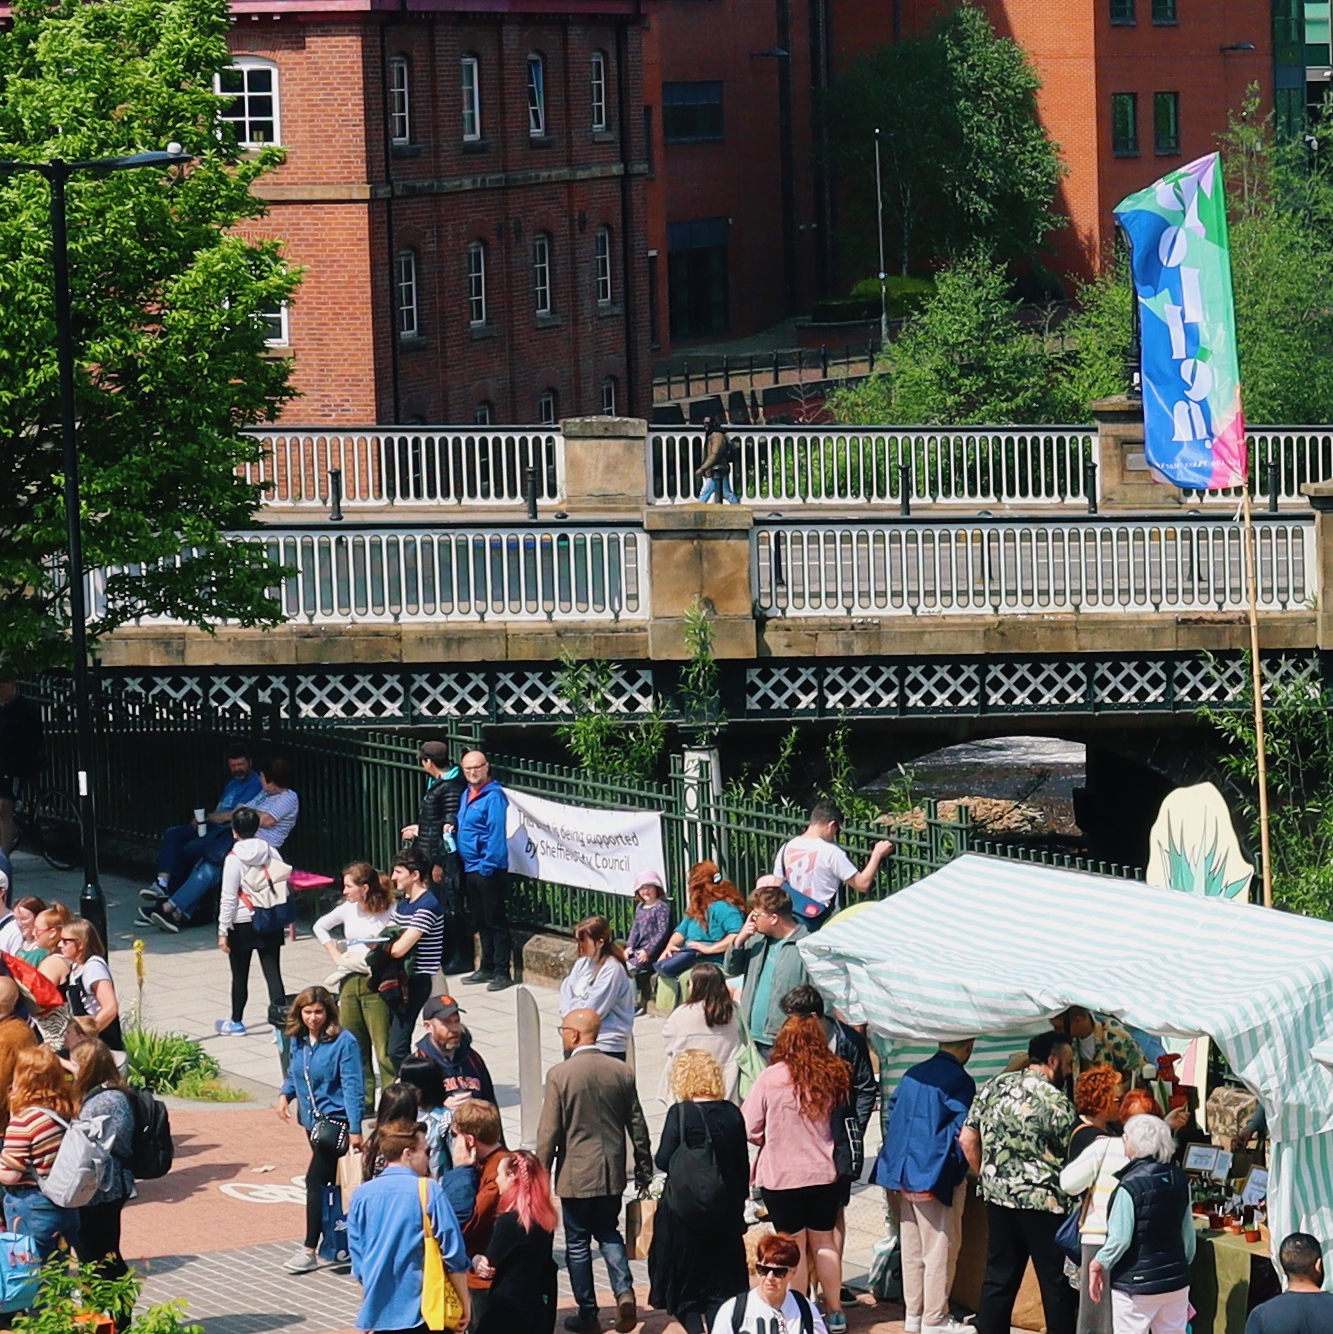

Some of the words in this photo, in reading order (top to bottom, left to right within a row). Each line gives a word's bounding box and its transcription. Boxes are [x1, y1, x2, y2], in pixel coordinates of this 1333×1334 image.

[586, 832, 639, 849] supported
[525, 837, 539, 859] by
[594, 852, 631, 873] Council
